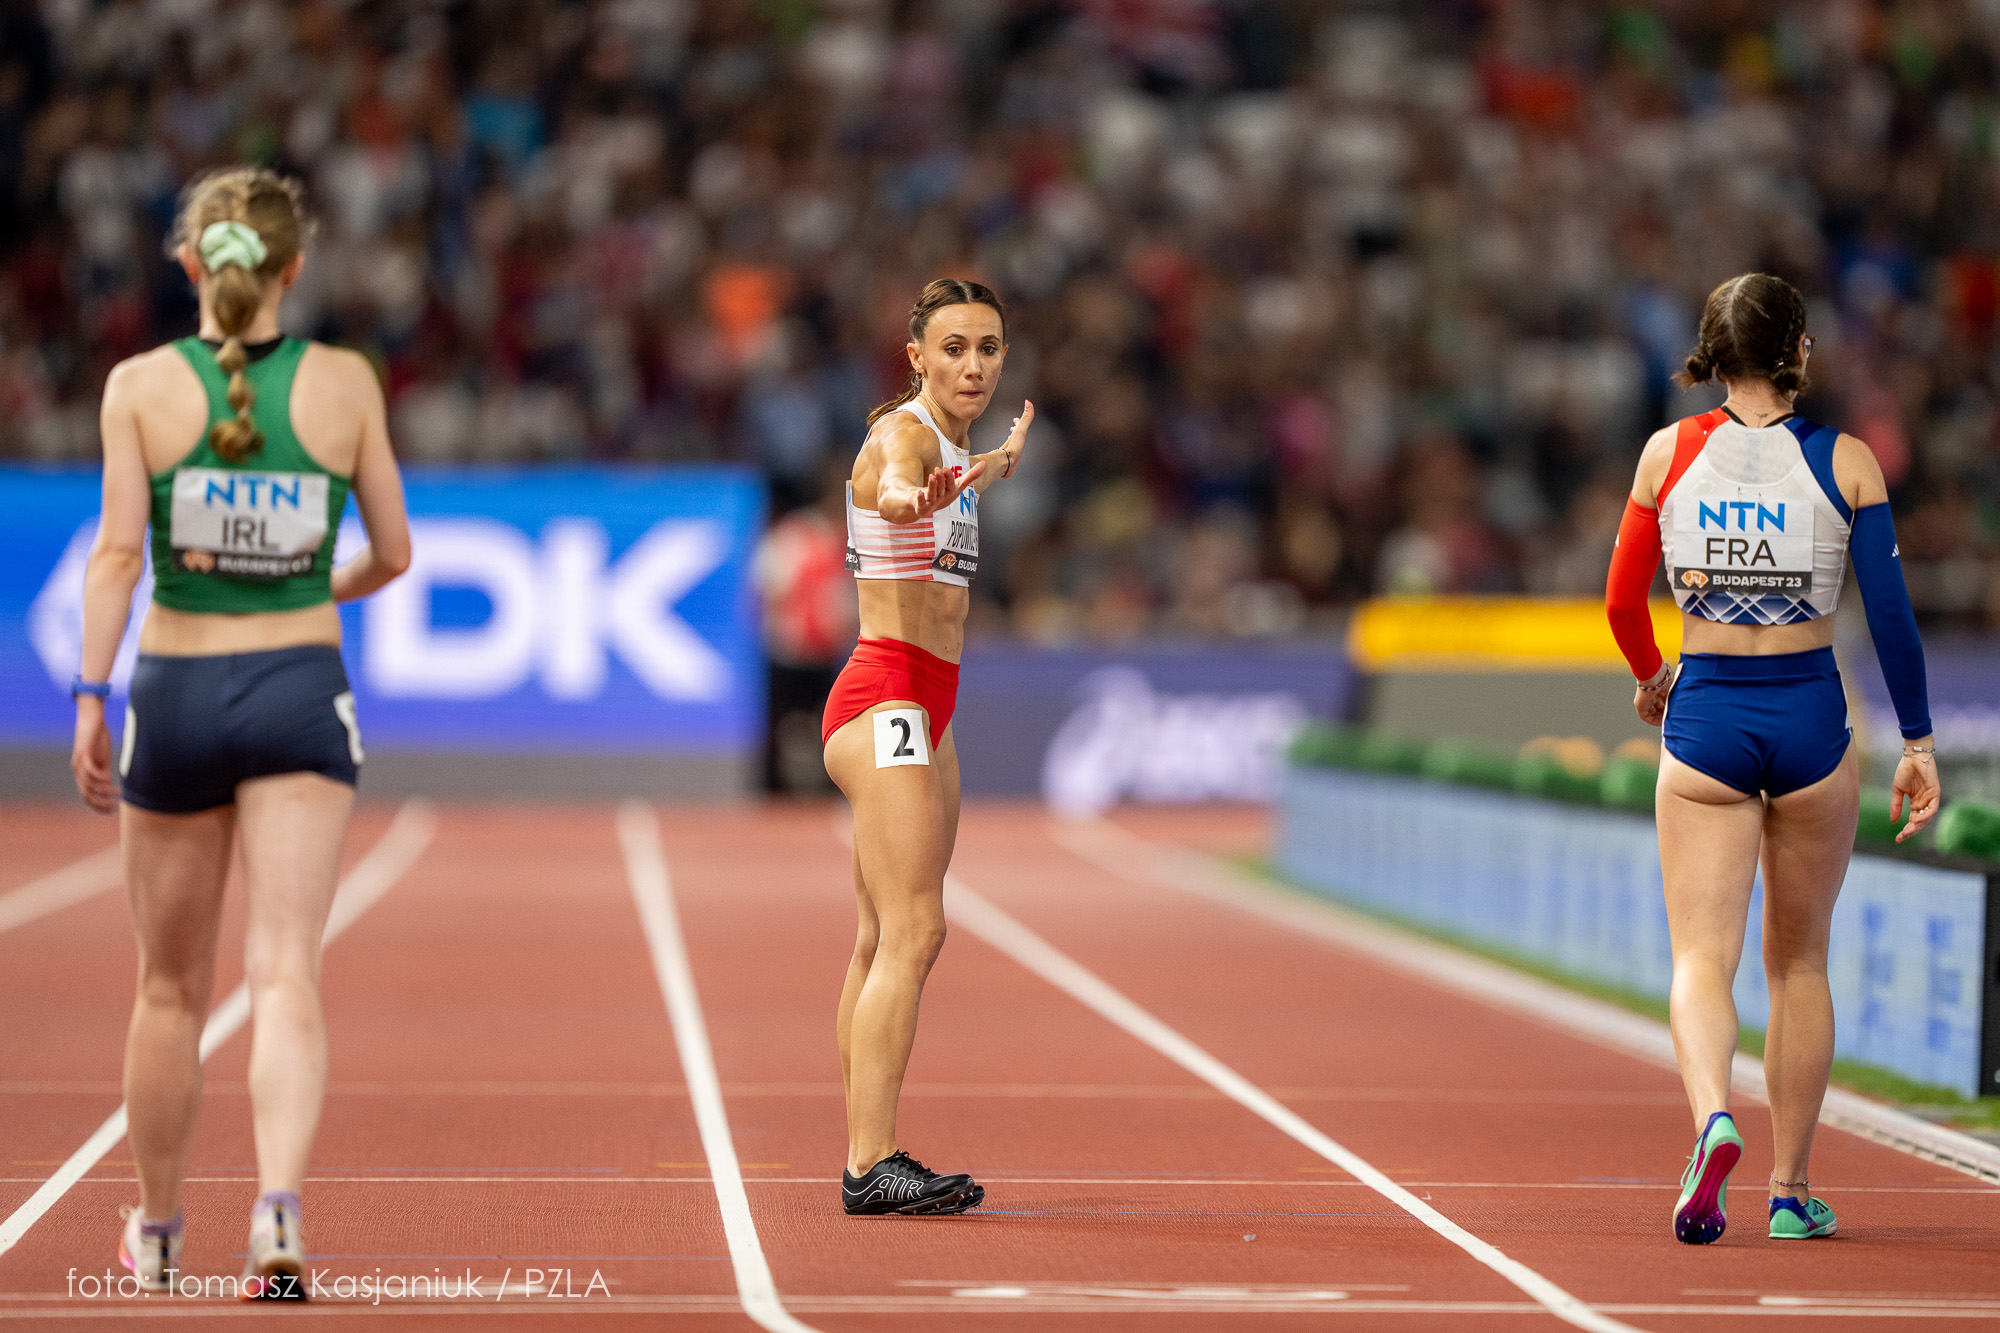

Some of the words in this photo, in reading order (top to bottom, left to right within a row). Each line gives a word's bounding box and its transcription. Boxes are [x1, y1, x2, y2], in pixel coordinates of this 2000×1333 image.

[205, 474, 300, 510] NTN
[221, 515, 280, 549] IRL
[1698, 500, 1786, 534] NTN
[1705, 536, 1778, 568] FRA
[1712, 574, 1785, 588] BUDAPEST
[1785, 576, 1803, 588] 23
[335, 517, 736, 701] DK
[889, 717, 915, 758] 2
[864, 1173, 925, 1204] AIR
